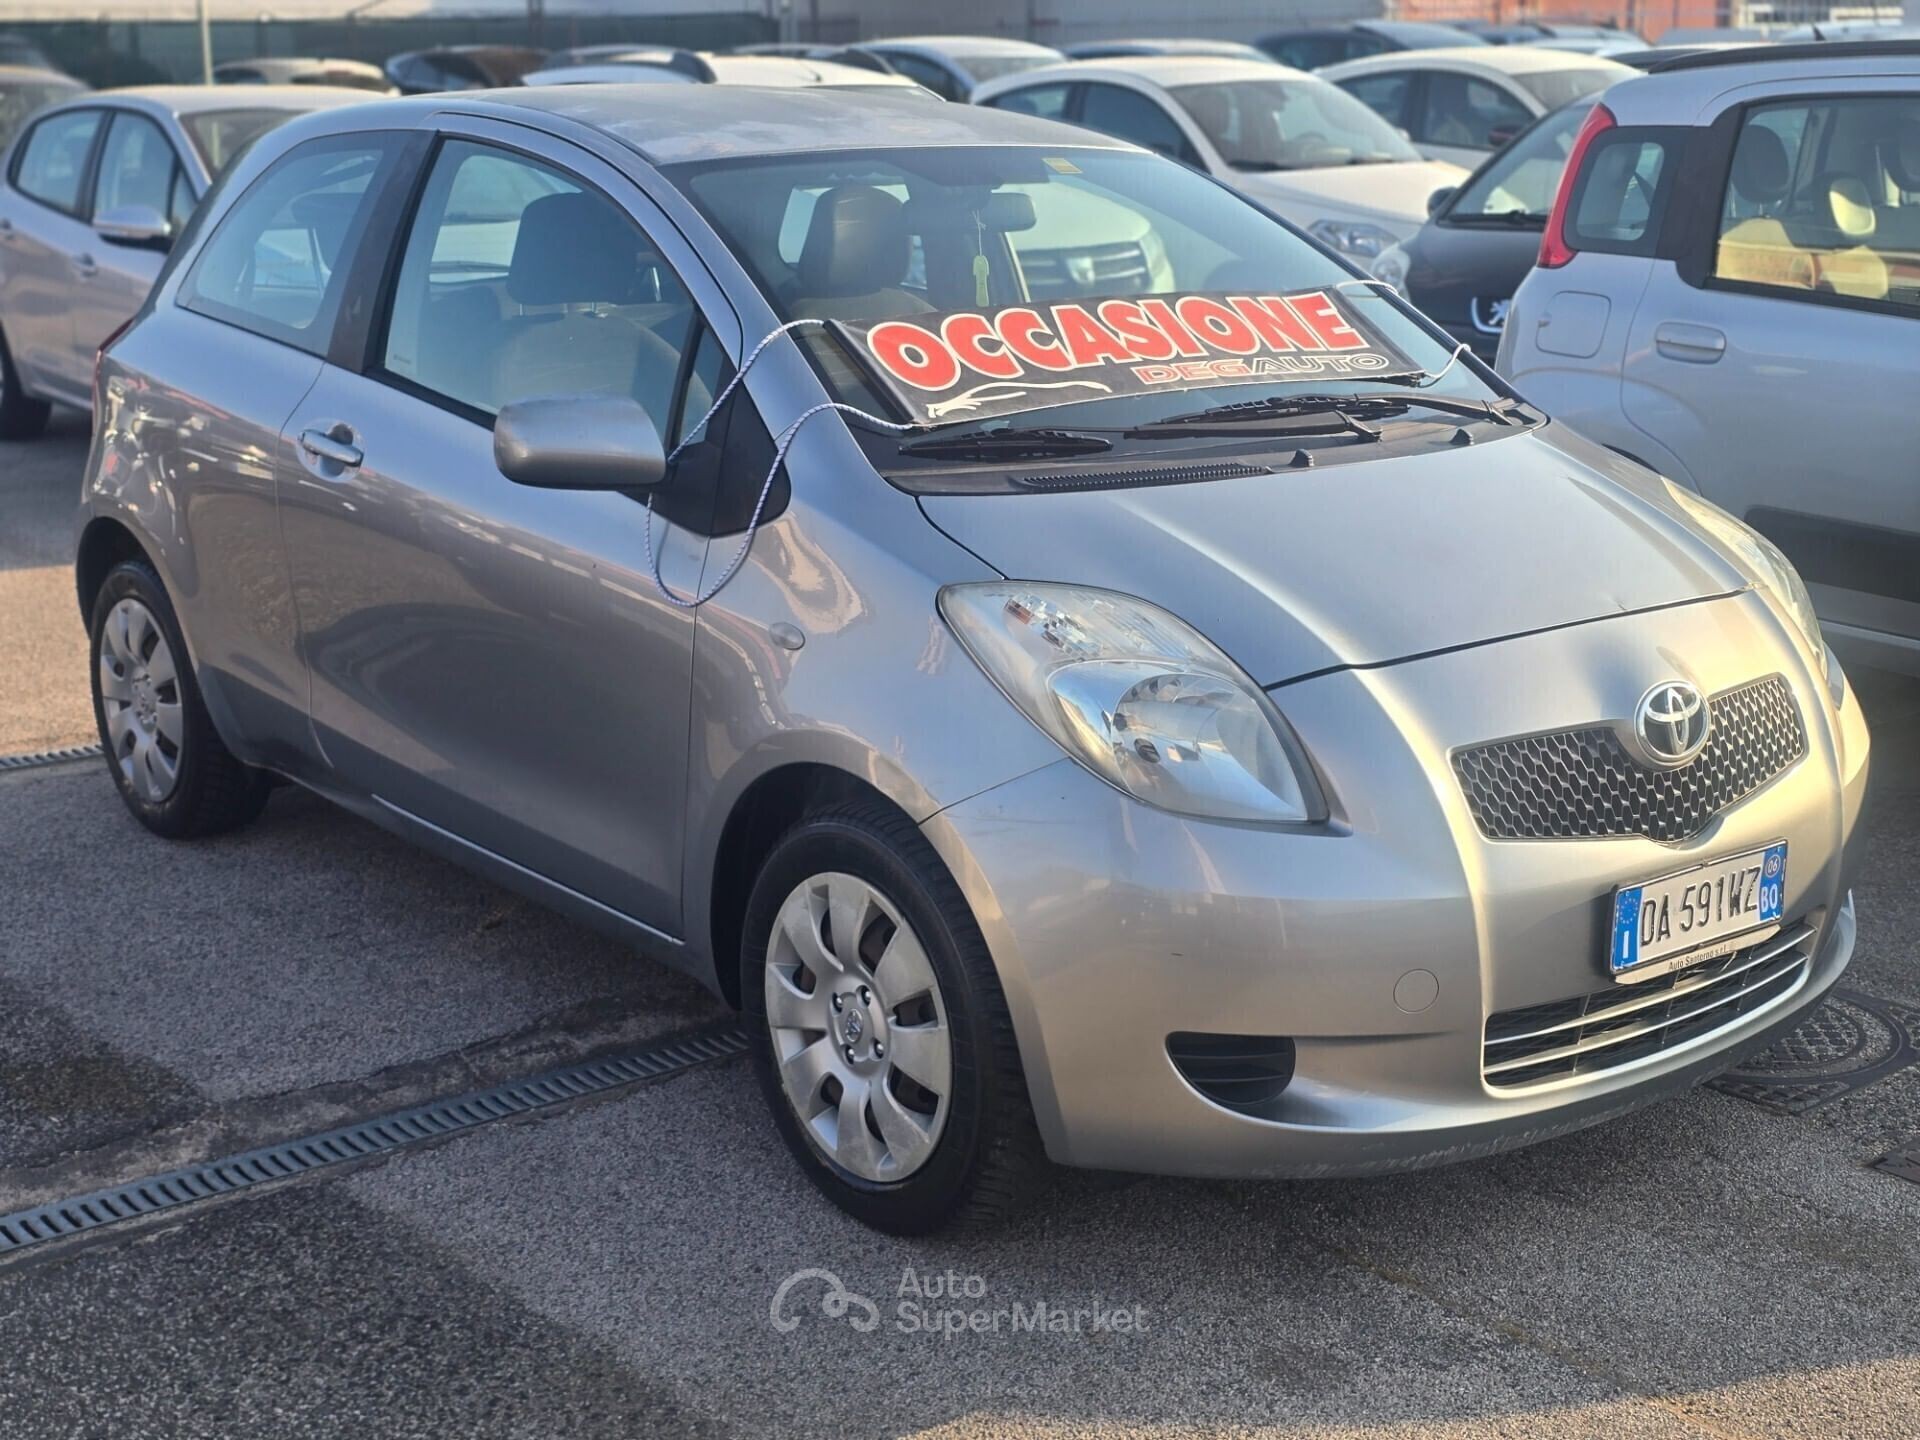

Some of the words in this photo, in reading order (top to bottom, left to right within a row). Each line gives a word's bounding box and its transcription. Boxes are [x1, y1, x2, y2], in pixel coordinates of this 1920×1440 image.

[867, 291, 1371, 390] OCCASIONE
[1131, 353, 1389, 385] DEGAUTO
[1767, 859, 1778, 873] 06
[1761, 883, 1778, 912] BO
[1641, 893, 1671, 946] DA
[1622, 930, 1629, 959] I
[1668, 960, 1684, 971] Auto
